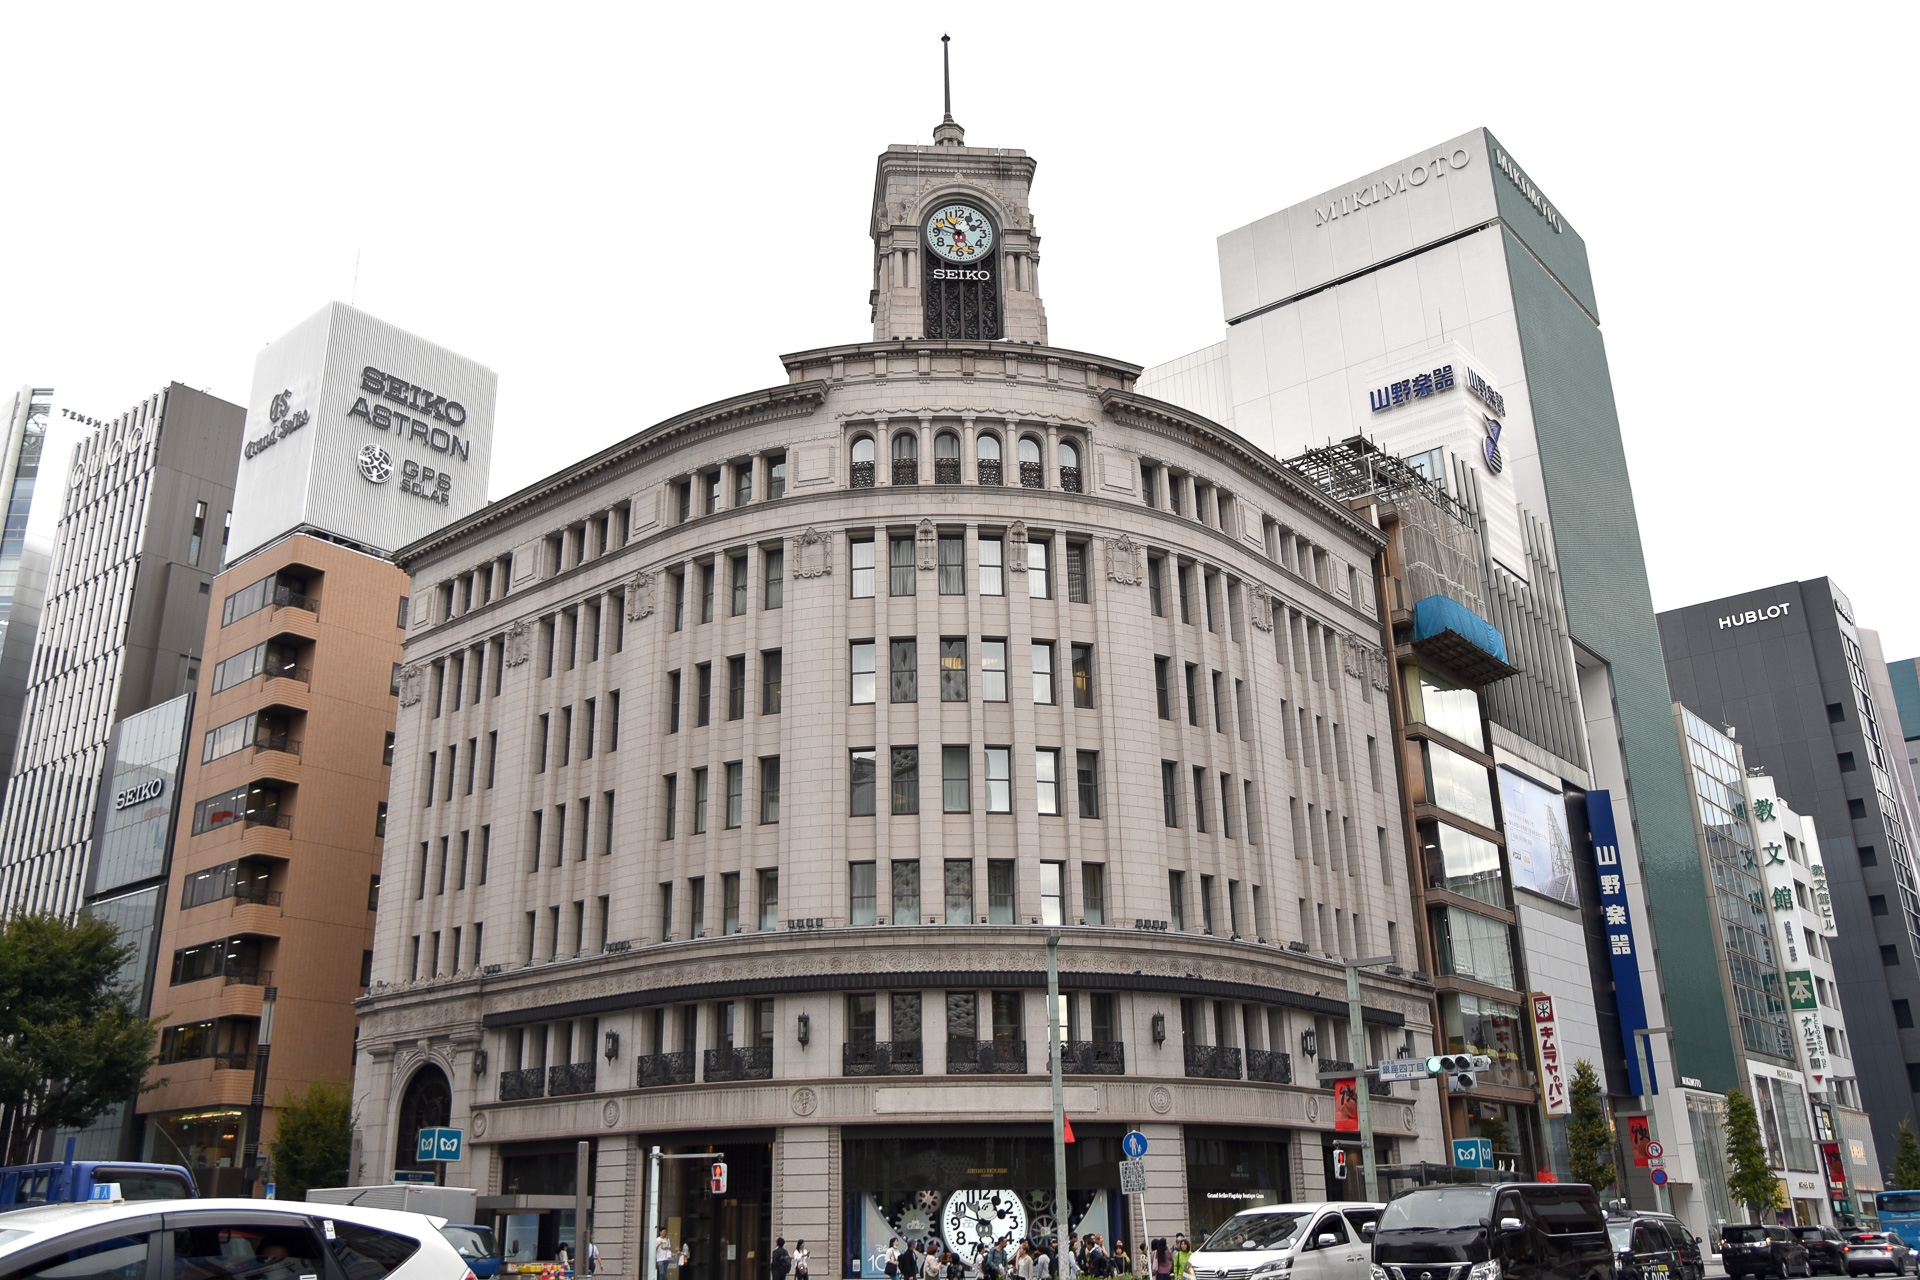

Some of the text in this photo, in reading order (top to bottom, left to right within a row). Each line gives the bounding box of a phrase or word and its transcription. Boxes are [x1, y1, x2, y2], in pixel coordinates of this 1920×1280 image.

[1315, 148, 1471, 226] MIKIMOTO
[1495, 147, 1562, 234] MIKIMOTO
[933, 269, 990, 280] SEIKO
[360, 366, 466, 427] SEIKO
[1370, 365, 1454, 412] 山野楽器
[1467, 366, 1506, 417] 山野楽器
[347, 397, 470, 461] ASTRON
[70, 417, 155, 489] GUCCI
[402, 459, 451, 491] GPS
[400, 478, 449, 506] SOLAR
[1718, 602, 1790, 630] HUBLOT
[115, 778, 162, 810] SEIKO
[1754, 798, 1793, 912] 教文館
[1596, 846, 1631, 955] 山野楽器
[1811, 864, 1834, 931] 教文館ビル
[1789, 977, 1812, 1003] 本
[1801, 1016, 1822, 1069] ナルニア国
[1382, 1063, 1424, 1074] 銀座四丁目
[1540, 1027, 1562, 1108] キムラヤのパン
[1004, 1200, 1013, 1214] 2
[1009, 1216, 1019, 1229] 3
[951, 1217, 960, 1230] 9
[956, 1231, 966, 1245] 8
[1005, 1231, 1014, 1245] 4
[968, 1242, 978, 1256] 7
